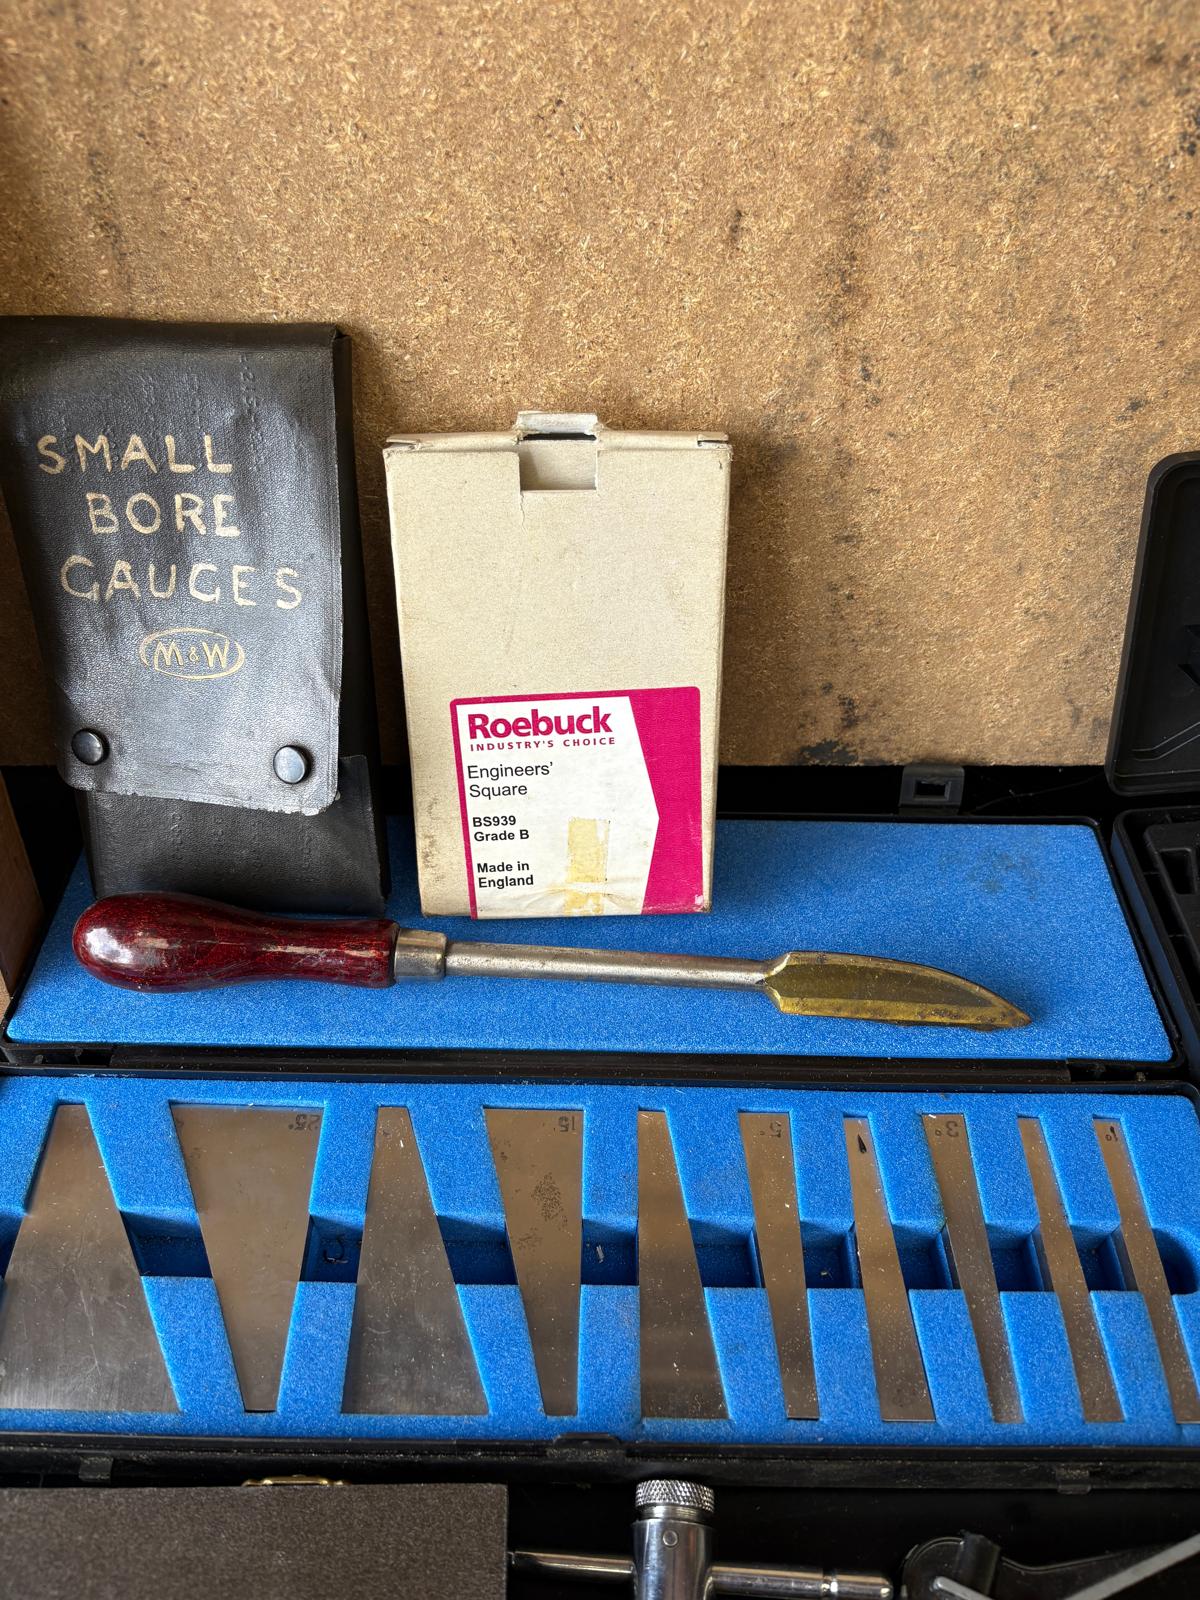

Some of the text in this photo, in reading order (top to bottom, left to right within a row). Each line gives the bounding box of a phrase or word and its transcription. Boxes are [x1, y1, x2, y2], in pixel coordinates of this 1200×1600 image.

[37, 434, 233, 474] SMALL
[86, 493, 241, 537] BORE
[60, 555, 303, 609] GAUGES
[468, 706, 613, 739] Roebuck
[470, 737, 616, 751] INDUSTRY'S CHOICE
[469, 782, 528, 800] Square
[472, 815, 516, 827] BS939
[474, 829, 530, 842] Grade B
[477, 861, 530, 873] Made in
[478, 875, 534, 889] England
